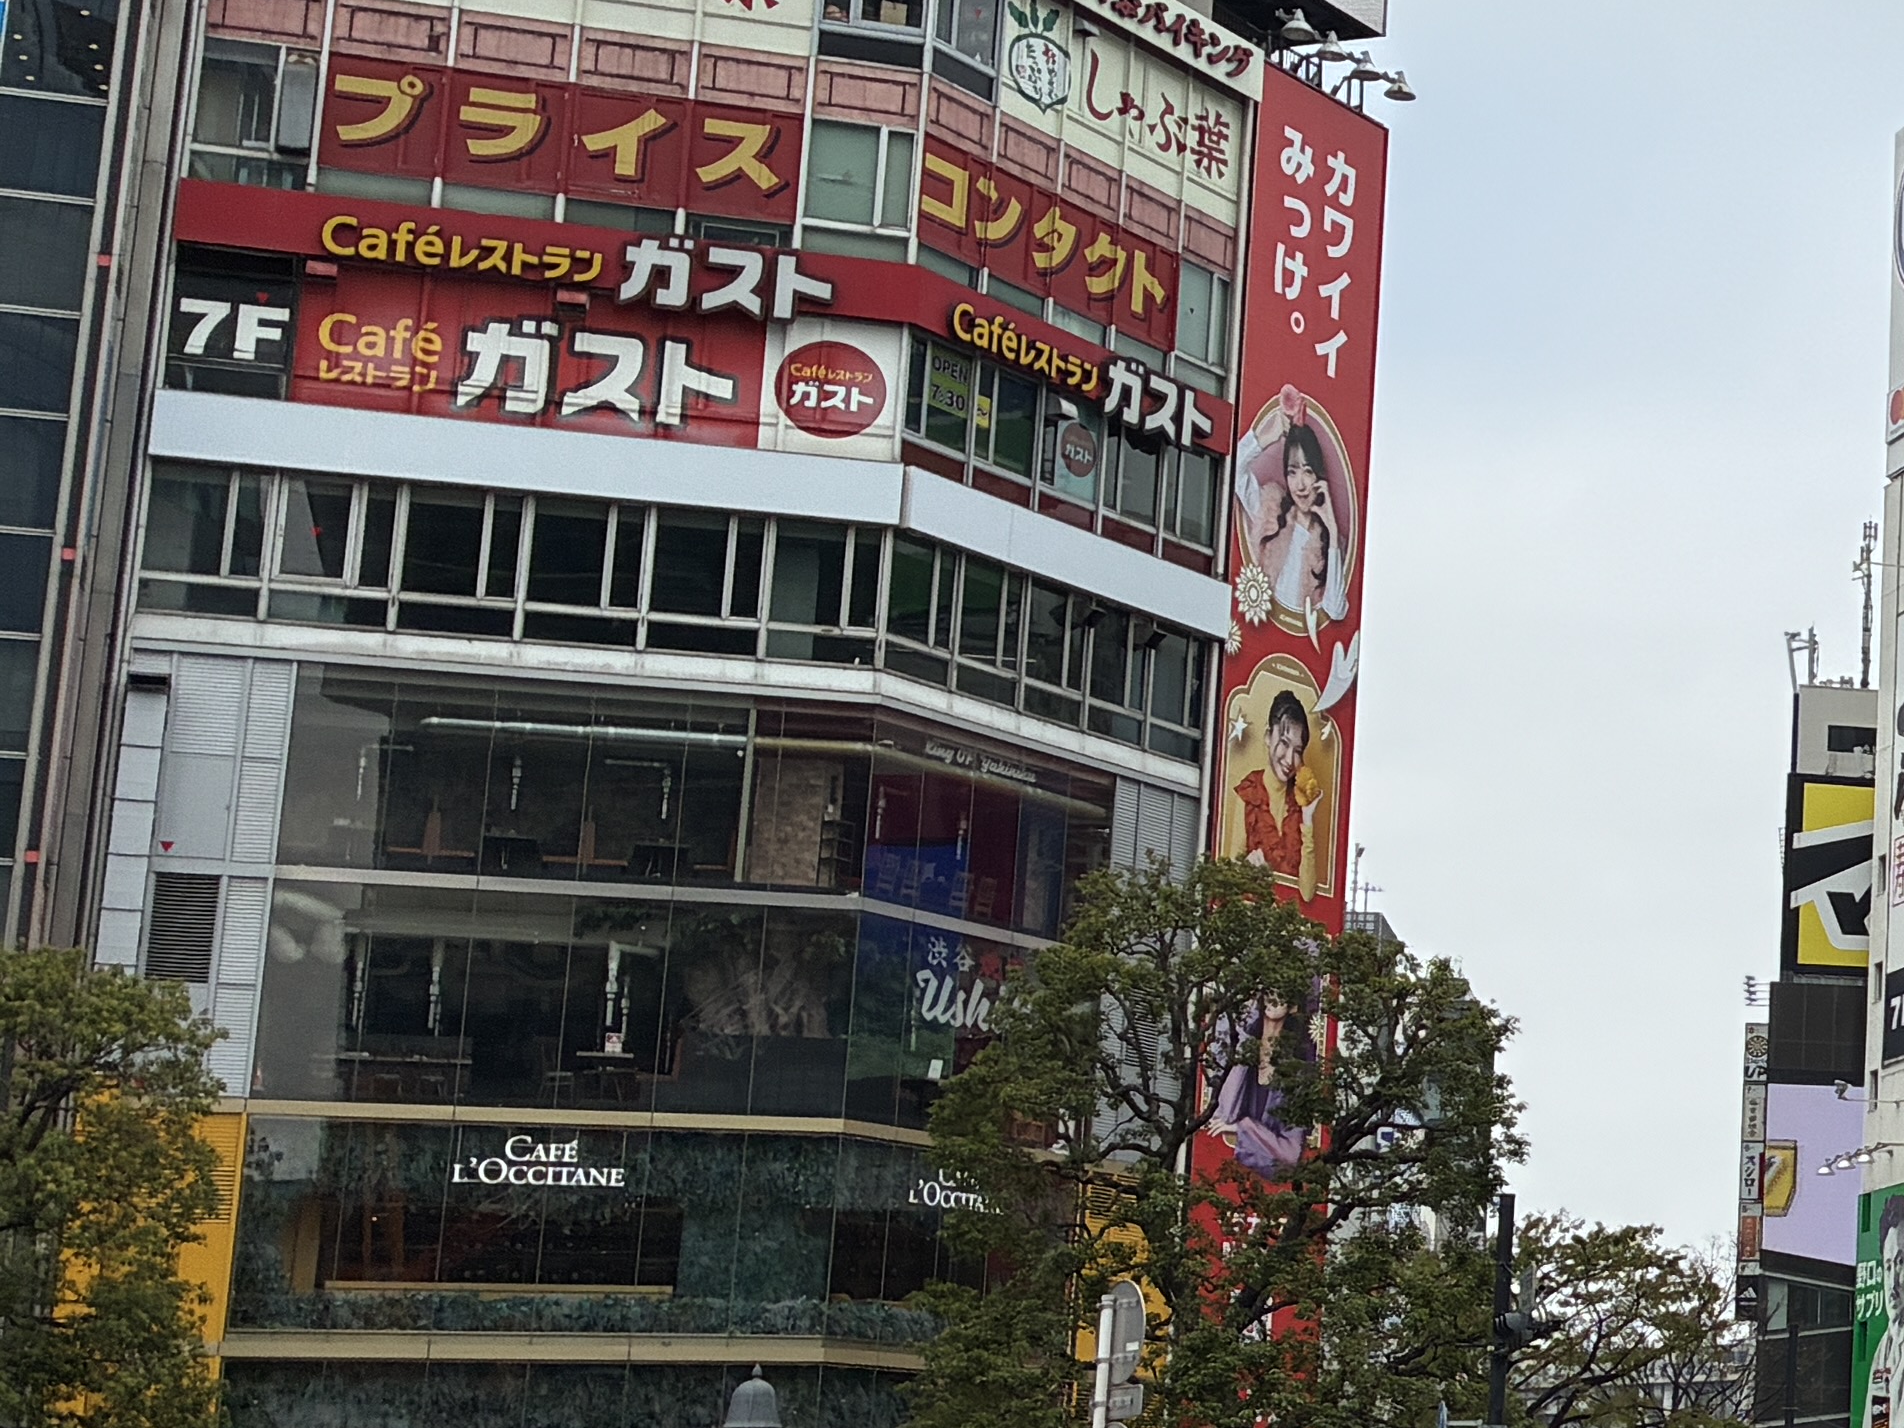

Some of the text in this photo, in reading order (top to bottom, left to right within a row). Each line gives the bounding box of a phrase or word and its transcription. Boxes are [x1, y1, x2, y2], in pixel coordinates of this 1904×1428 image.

[334, 73, 783, 198] プライス
[1085, 47, 1231, 181] しゃぶ葉
[921, 155, 1166, 320] コンタクト
[1273, 124, 1315, 335] みつけ。
[1314, 149, 1358, 380] カワイイ
[617, 237, 835, 321] ガスト
[179, 296, 292, 361] 7F
[317, 312, 740, 426] Café ガスト
[931, 353, 970, 385] OPEN
[319, 357, 440, 394] レストラン
[787, 382, 875, 413] ガスト
[1102, 357, 1213, 450] ガスト
[926, 934, 977, 974] 渋谷
[452, 1157, 626, 1188] L'OCCITANE
